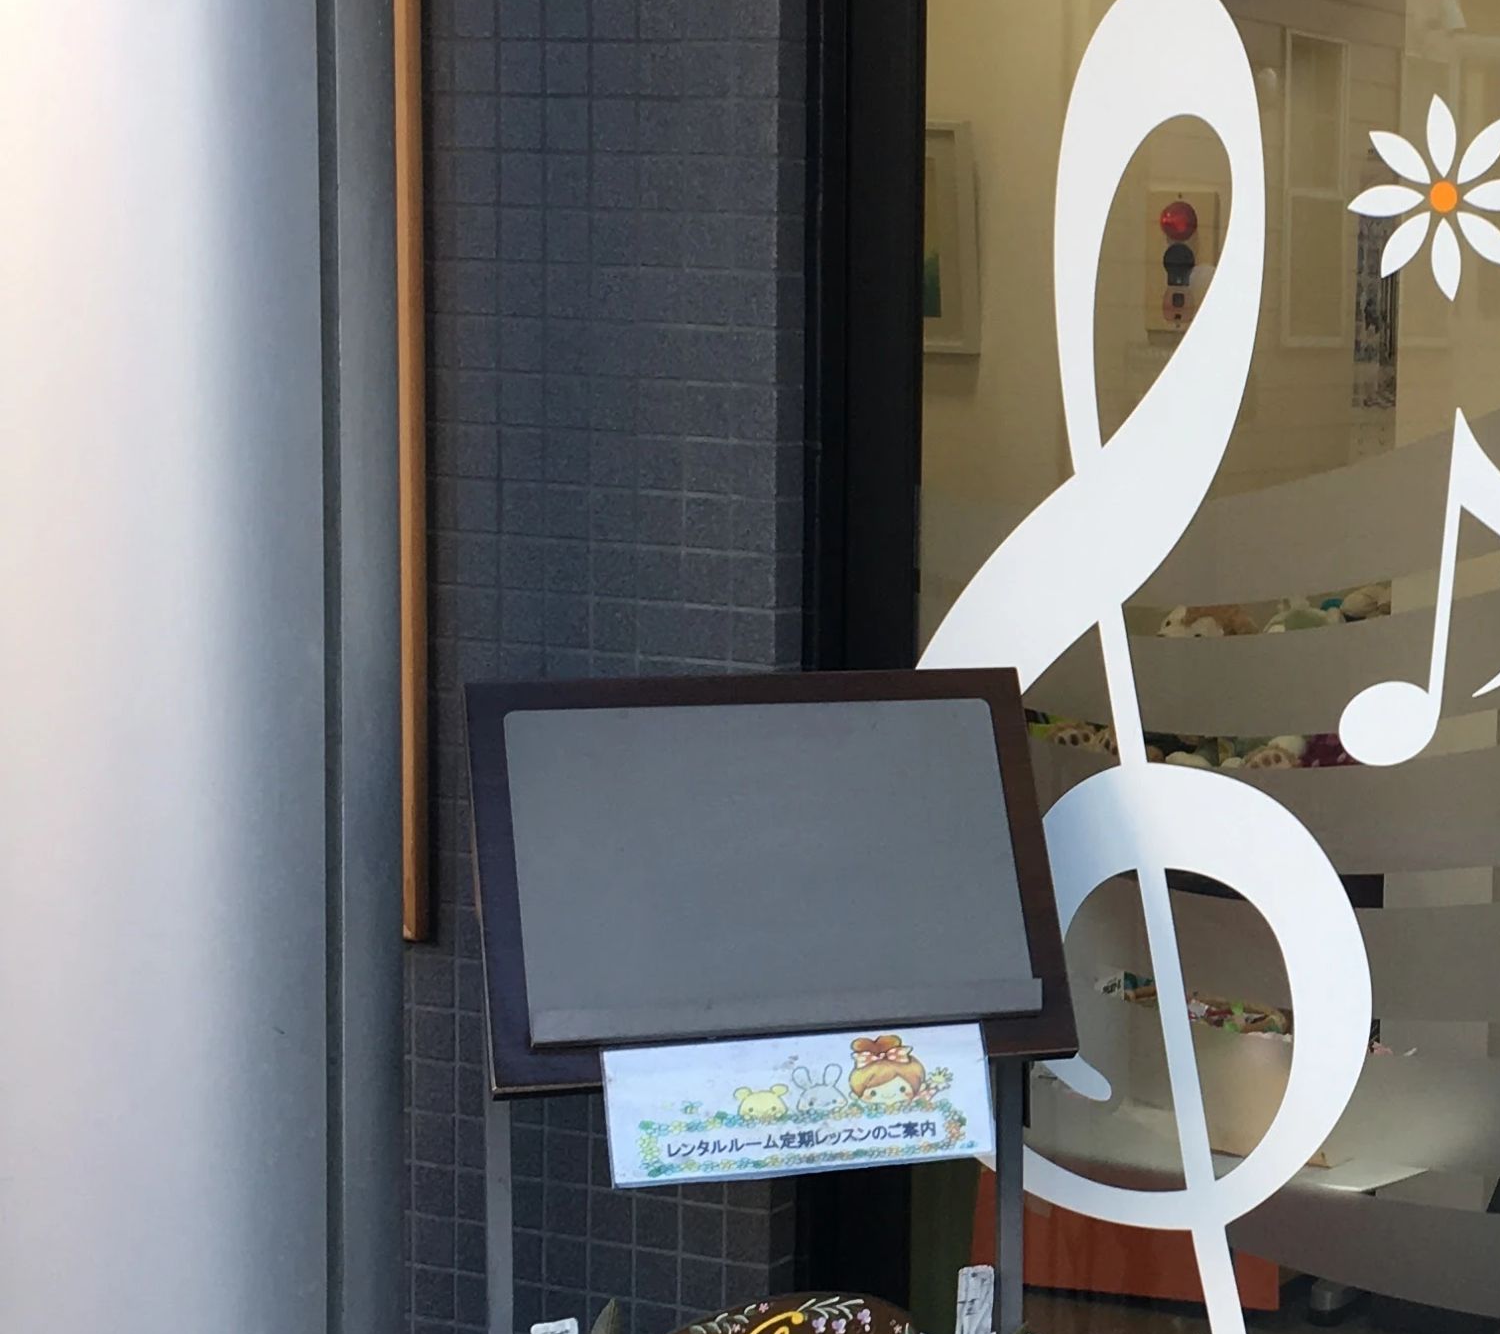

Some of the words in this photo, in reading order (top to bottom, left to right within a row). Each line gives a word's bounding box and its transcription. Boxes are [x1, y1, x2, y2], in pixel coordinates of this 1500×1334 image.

[667, 1120, 937, 1158] レンタルルーム定期レッスンのご案内
